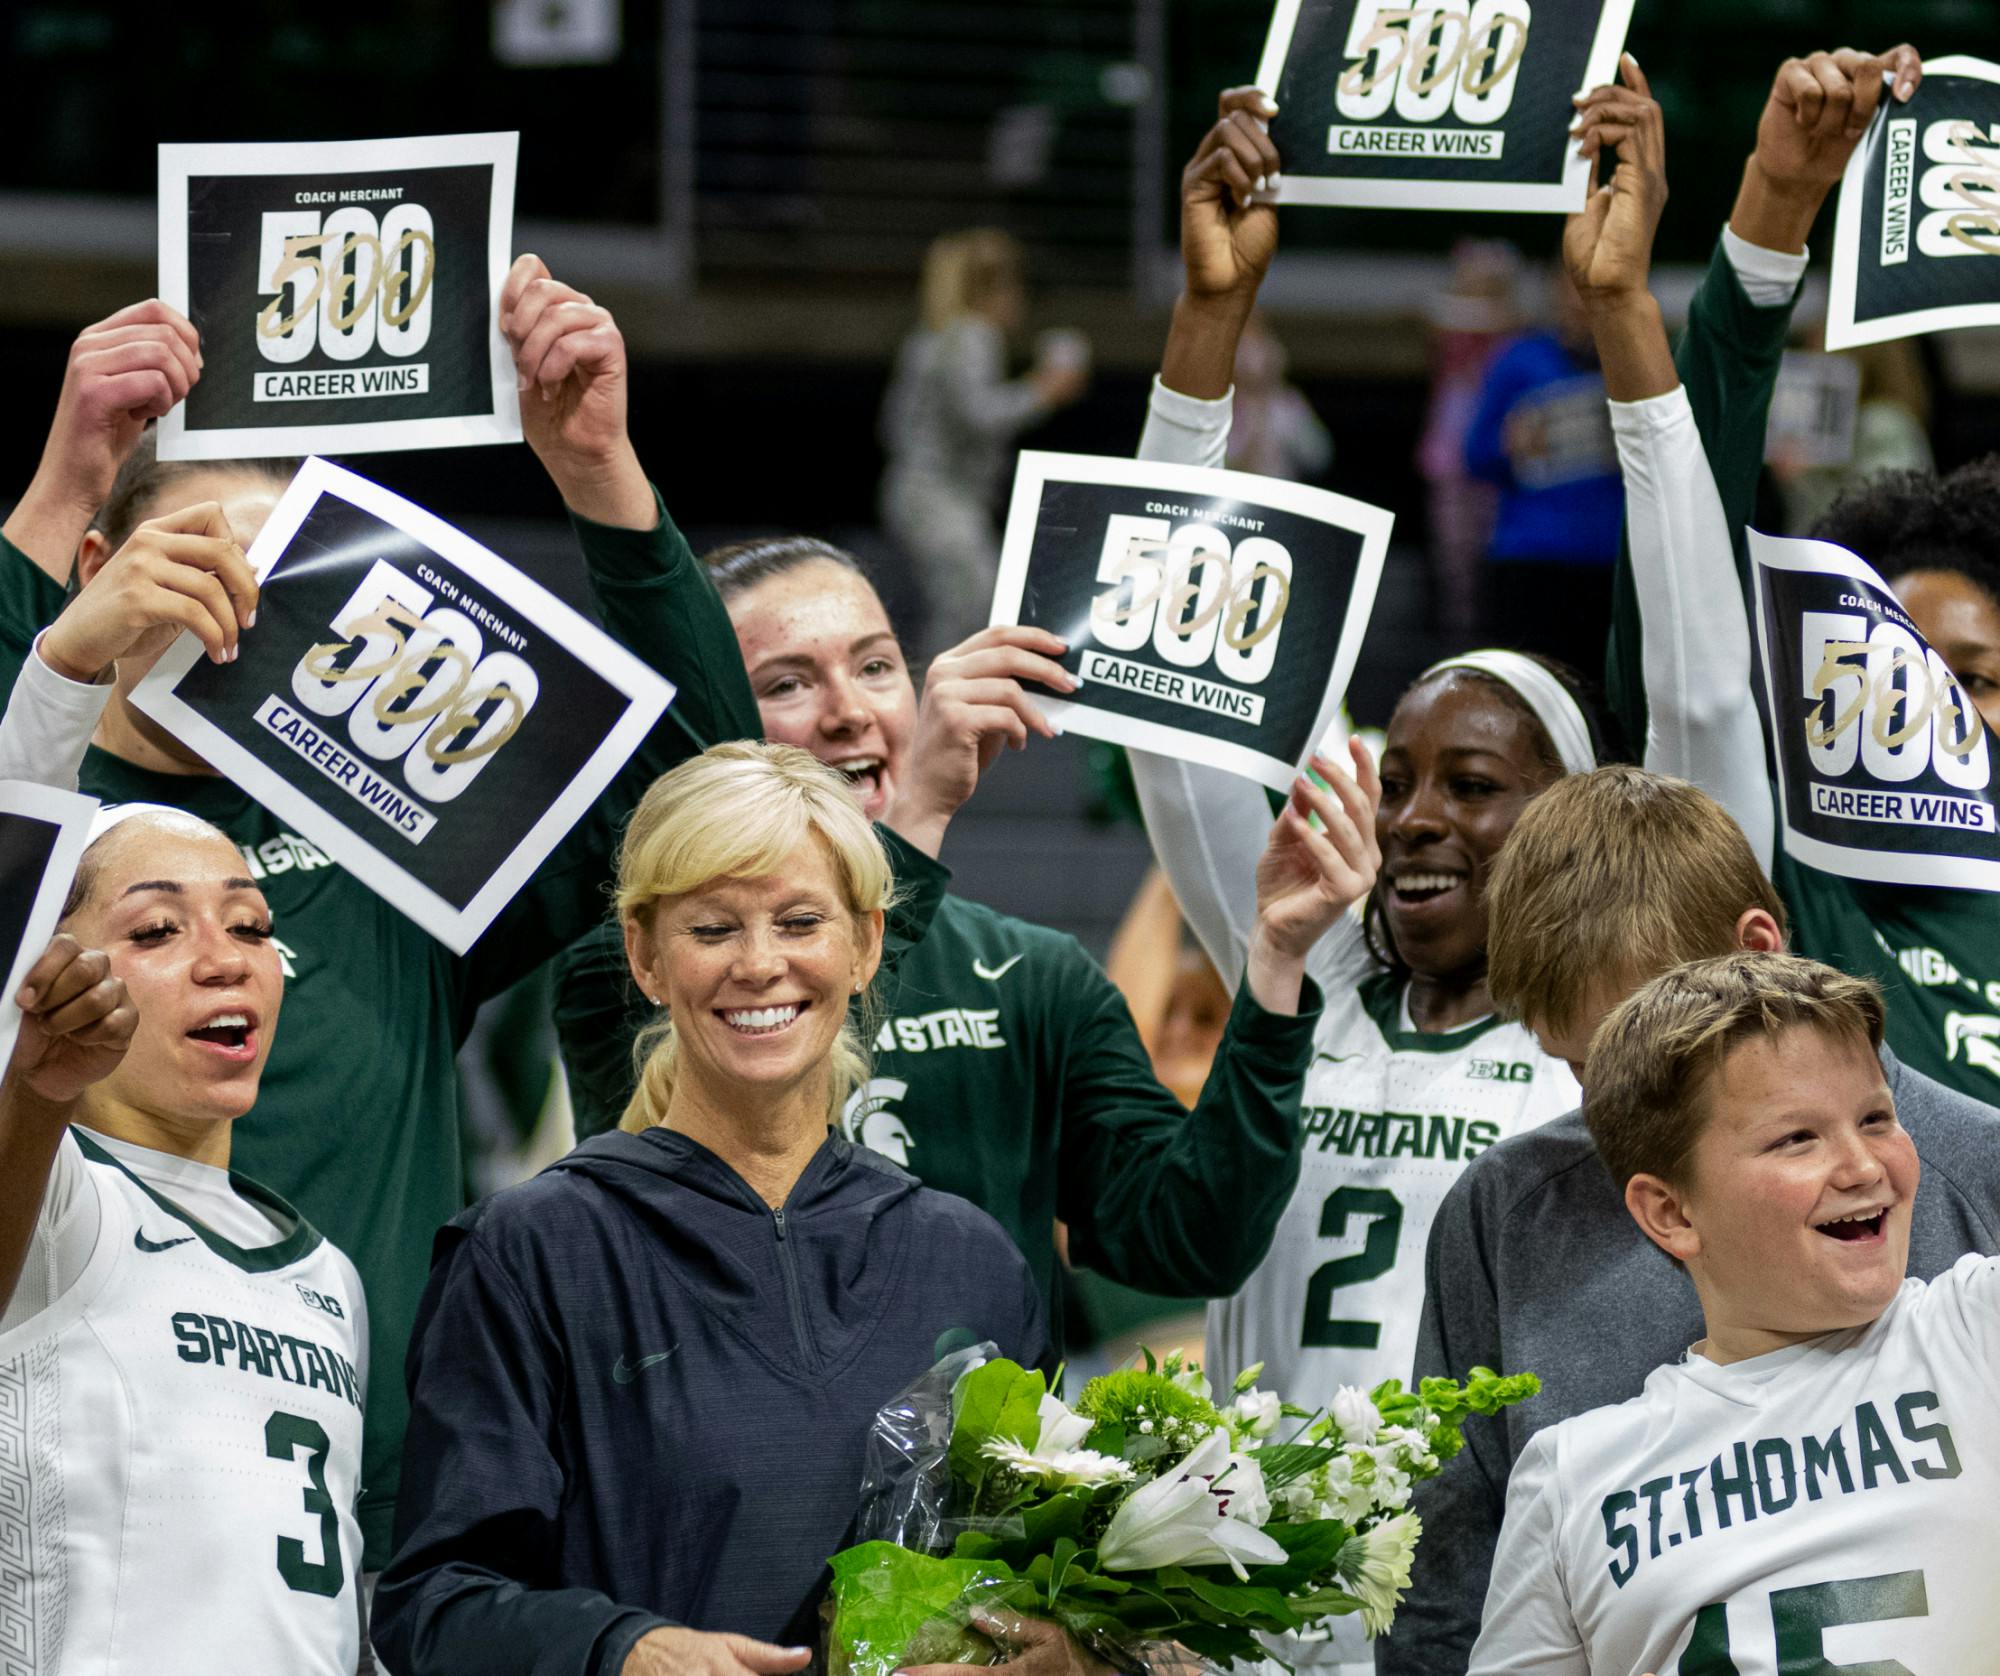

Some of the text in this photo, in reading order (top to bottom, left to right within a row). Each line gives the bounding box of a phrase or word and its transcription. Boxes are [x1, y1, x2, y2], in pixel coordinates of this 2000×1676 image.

[1335, 0, 1532, 125] 500
[296, 188, 404, 204] COACH MERCHANT
[1338, 130, 1493, 154] CAREER WINS
[1885, 128, 1911, 255] CAREER WINS
[256, 203, 434, 363] 500
[265, 369, 418, 397] CAREER WINS
[1145, 502, 1264, 532] COACH MERCHANT
[416, 563, 528, 652] COACH MERCHANT
[1089, 513, 1293, 685] 500
[1839, 593, 1882, 614] COACH
[291, 557, 539, 803] 500
[1091, 657, 1254, 718] CAREER WINS
[1802, 611, 1991, 791] 500
[267, 706, 425, 833] CAREER WINS
[1817, 788, 1984, 827] CAREER WINS
[1303, 1185, 1404, 1348] 2
[264, 1411, 344, 1598] 3
